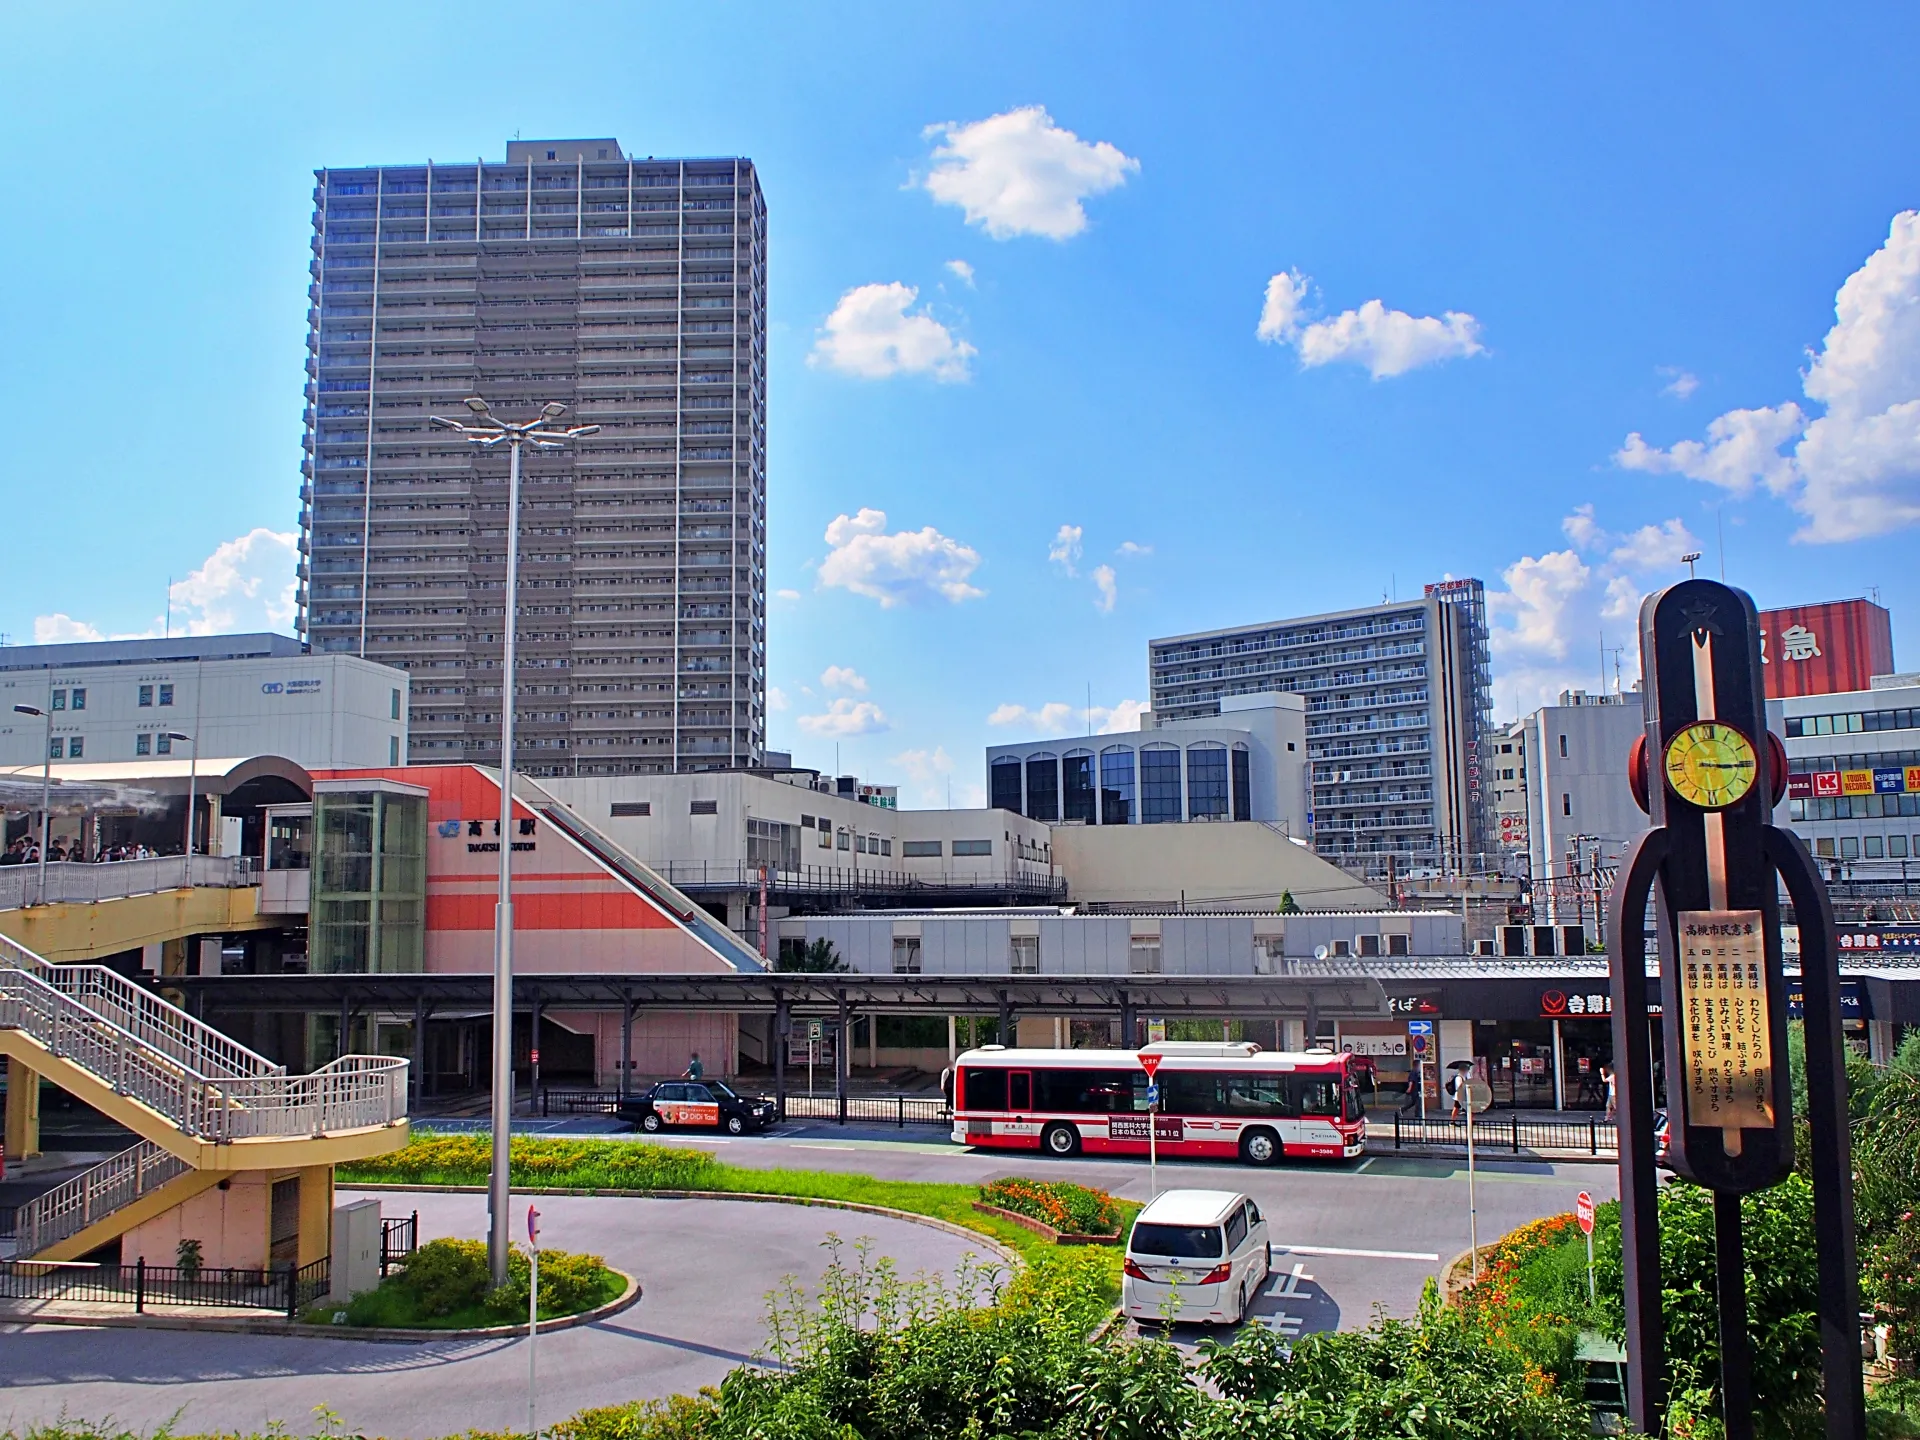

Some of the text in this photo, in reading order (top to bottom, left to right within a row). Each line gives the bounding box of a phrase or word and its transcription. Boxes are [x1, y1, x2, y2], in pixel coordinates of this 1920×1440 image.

[1845, 781, 1872, 791] RECORDS
[1846, 774, 1867, 782] TOWER
[1686, 924, 1754, 936] 高槻市民憲章
[1688, 963, 1698, 989] 高槻は
[1703, 963, 1714, 989] 高槻は
[1718, 963, 1728, 989] 高槻は
[1732, 963, 1743, 989] 高槻は
[1748, 963, 1758, 989] 高槻は
[1689, 998, 1701, 1042] 文化の華を
[1704, 998, 1717, 1059] 生きるよろこび
[1719, 998, 1732, 1050] 住みよい環境
[1734, 998, 1746, 1034] 心と心を
[1750, 998, 1763, 1059] わたくしたちの
[1692, 1050, 1704, 1095] 咲かすまち
[1737, 1042, 1748, 1078] 結ぶまち
[1708, 1068, 1719, 1112] 燃やすまち
[1723, 1060, 1734, 1104] めざすまち
[1754, 1068, 1765, 1113] 自治のまち
